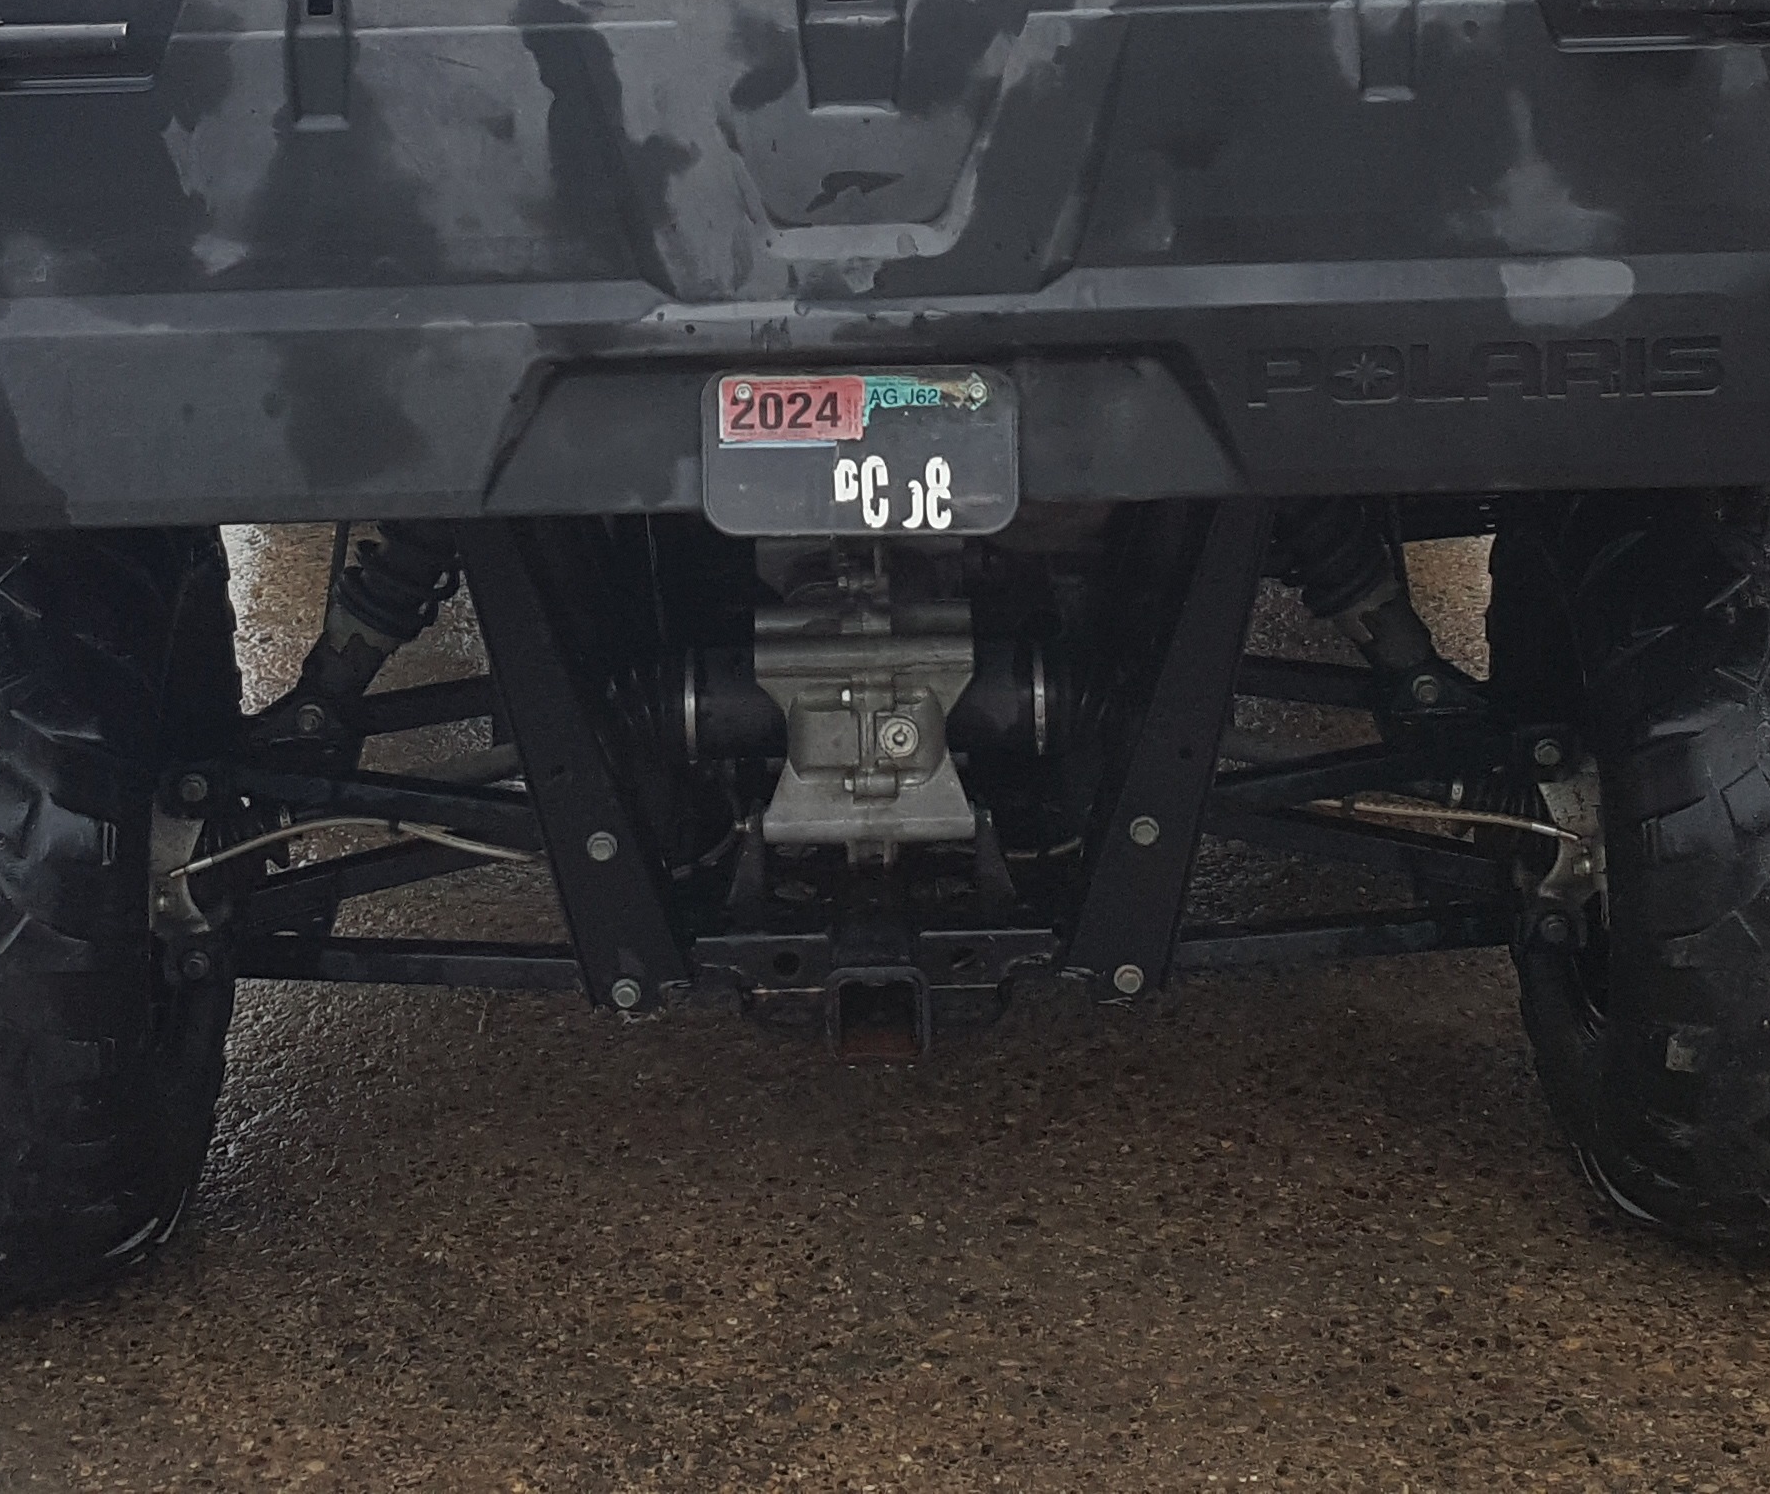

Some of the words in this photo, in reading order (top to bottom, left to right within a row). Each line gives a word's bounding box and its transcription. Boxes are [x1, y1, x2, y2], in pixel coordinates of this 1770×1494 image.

[1247, 335, 1725, 406] POLARIS
[730, 392, 842, 430] 2024
[869, 388, 898, 405] AG
[905, 388, 939, 405] J62
